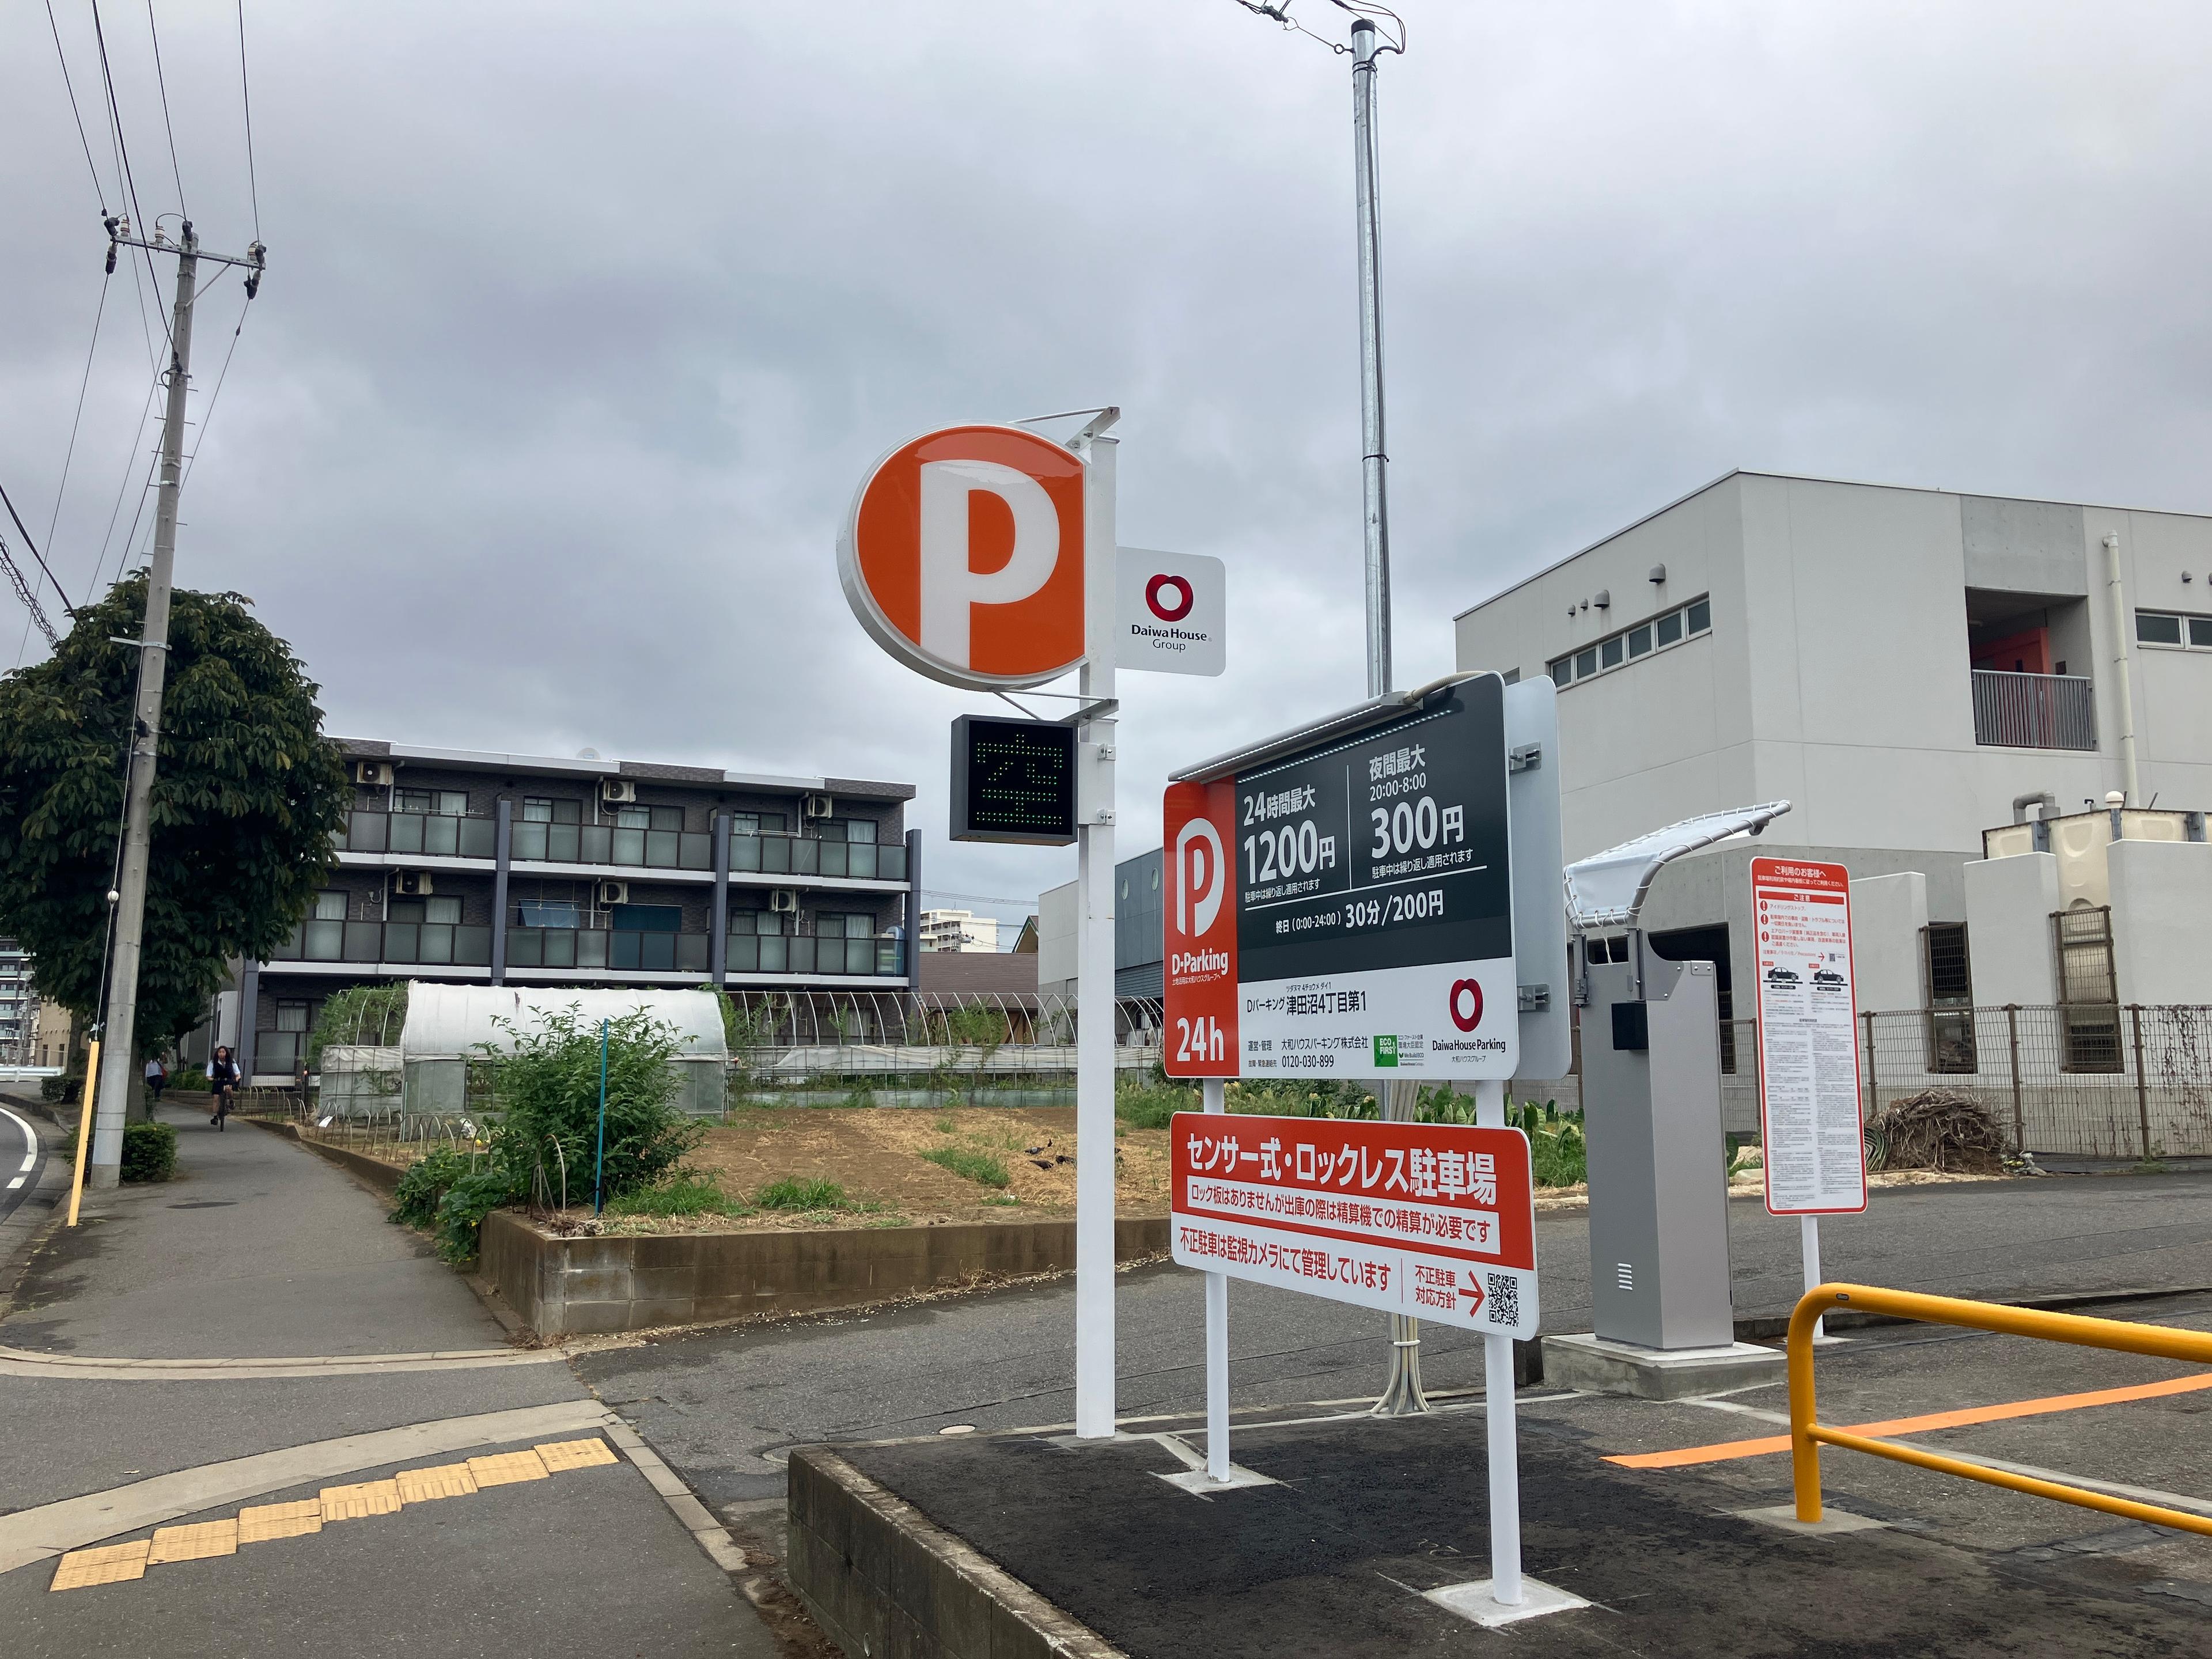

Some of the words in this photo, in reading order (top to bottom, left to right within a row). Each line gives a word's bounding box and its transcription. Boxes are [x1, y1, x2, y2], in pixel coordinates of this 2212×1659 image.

[920, 459, 1060, 671] P
[1131, 624, 1169, 638] Daiwa
[1171, 628, 1207, 641] House
[1153, 639, 1186, 653] Group
[1369, 744, 1426, 782] 夜間最大
[976, 733, 1063, 825] 空
[1370, 772, 1426, 802] 20:00-8:00
[1244, 784, 1316, 827] 24時間最大
[1371, 796, 1464, 859] 300円
[1244, 820, 1336, 885] 1200円
[1372, 848, 1474, 880] 駐車中は繰り返し適用されます
[1774, 866, 1827, 878] ご利用のお客様へ
[1244, 878, 1321, 903] 駐車中は繰り返し適用されます
[1793, 894, 1811, 902] ご注意
[1172, 947, 1228, 975] D-Parking
[1286, 990, 1367, 1016] 津田沼4丁目第1
[1176, 1015, 1225, 1062] 24h
[1248, 1040, 1272, 1051] 運営・管理
[1281, 1035, 1369, 1051] 大和ハウスパーキング株式会社
[1379, 1037, 1392, 1046] ECO
[1432, 1039, 1454, 1051] Daiwa
[1454, 1039, 1476, 1051] House
[1476, 1037, 1506, 1053] Parking
[1282, 1055, 1334, 1068] 0120-030-899
[1187, 1132, 1498, 1206] センサー式・ロックレス駐車場
[1191, 1184, 1491, 1243] ロック板はありませんが出庫の際は精算機での精算が必要です
[1180, 1226, 1391, 1291] 不正駐車は監視カメラにて管理しています
[1415, 1264, 1456, 1288] 不正駐車
[1415, 1285, 1457, 1310] 対応方針
